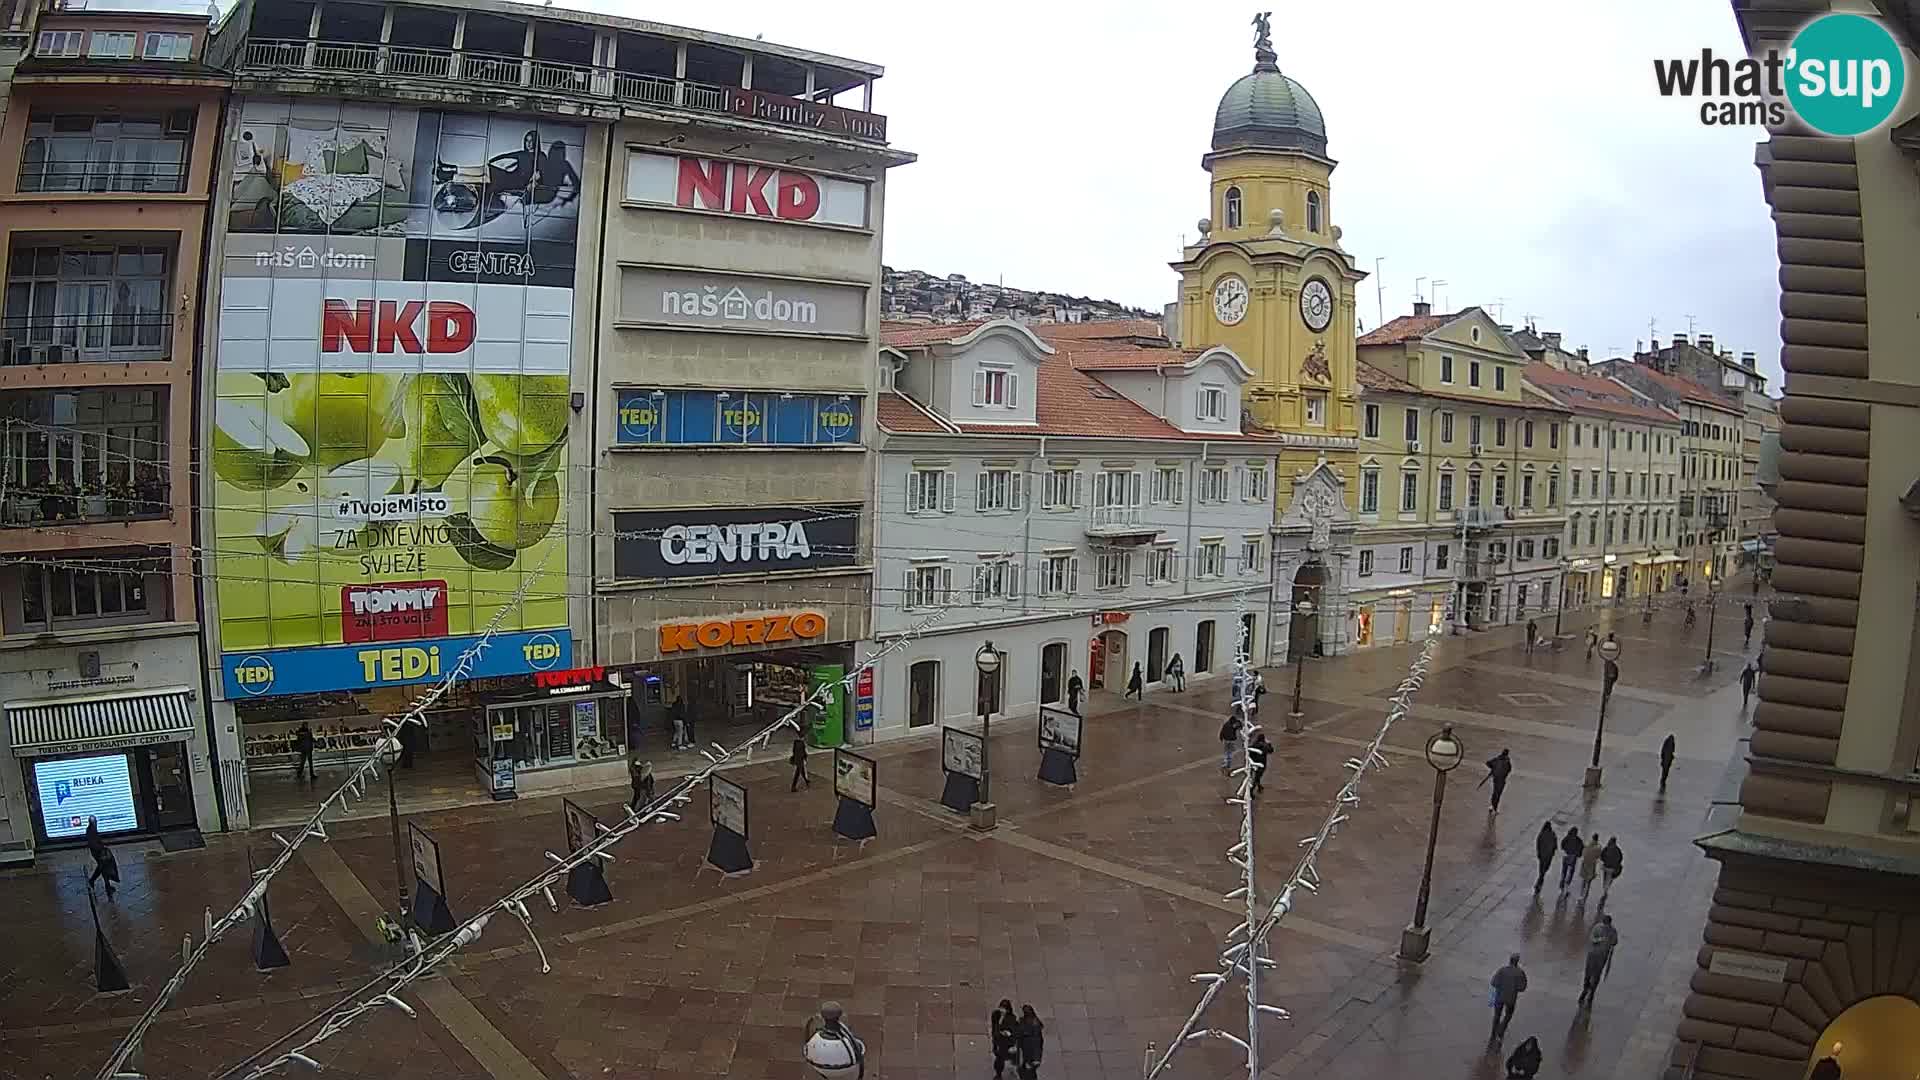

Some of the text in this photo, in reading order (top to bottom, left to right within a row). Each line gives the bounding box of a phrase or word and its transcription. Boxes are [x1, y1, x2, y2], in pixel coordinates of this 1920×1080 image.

[675, 158, 821, 220] NKD
[255, 246, 367, 269] naš dom
[449, 250, 536, 277] CENTRA
[662, 285, 817, 323] naš dom
[322, 298, 477, 354] NKD
[620, 409, 658, 425] TEDi
[724, 410, 760, 426] TEDi
[820, 411, 853, 427] TEDi
[338, 498, 447, 517] #TvojeMisto
[334, 523, 450, 549] ZA DNEVNO
[660, 522, 811, 564] CENTRA
[360, 547, 427, 575] SVJEŽE
[350, 589, 438, 615] TOMMY
[660, 613, 826, 653] KORZO
[359, 645, 440, 682] TEDi
[523, 643, 560, 661] TEDi
[235, 667, 274, 684] TEDi
[536, 666, 605, 688] TOMMY
[140, 734, 170, 745] CENTAR
[73, 776, 104, 788] RIJEKA
